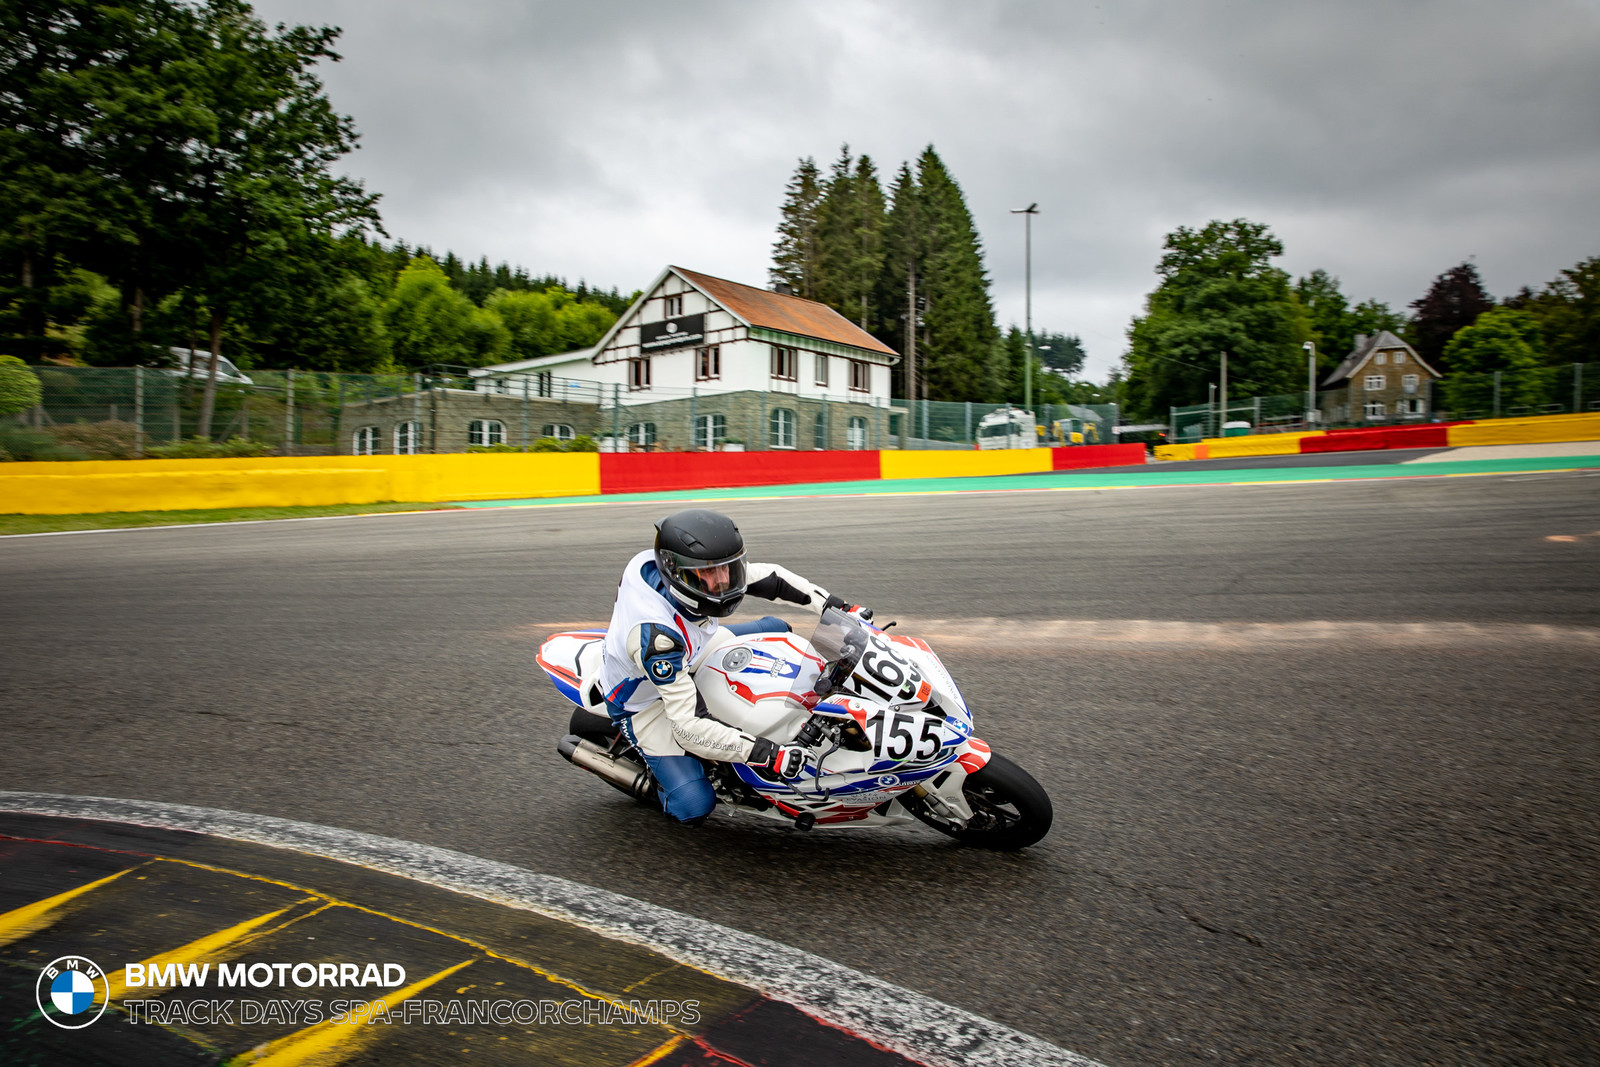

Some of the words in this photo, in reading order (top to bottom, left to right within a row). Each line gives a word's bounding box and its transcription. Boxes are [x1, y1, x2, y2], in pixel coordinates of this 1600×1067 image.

[851, 635, 909, 702] 168
[694, 735, 743, 753] Motorrad
[866, 709, 942, 760] 155
